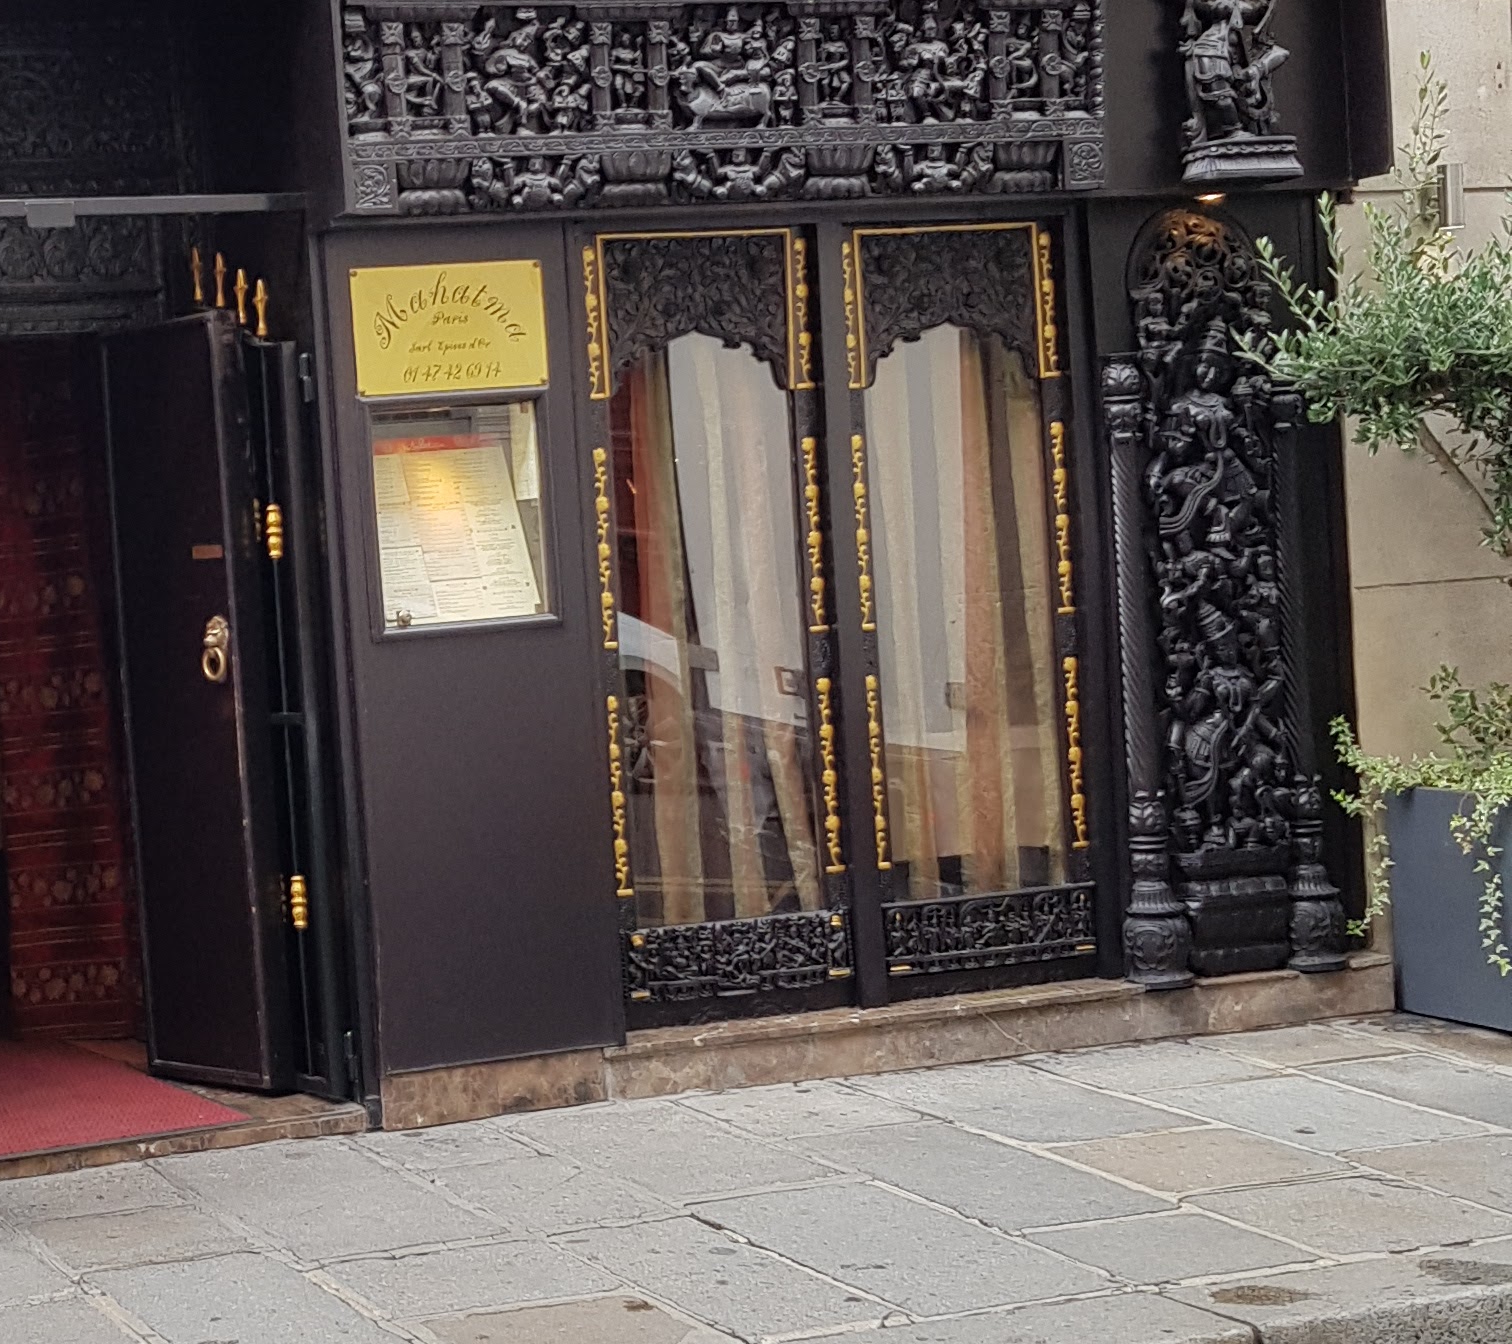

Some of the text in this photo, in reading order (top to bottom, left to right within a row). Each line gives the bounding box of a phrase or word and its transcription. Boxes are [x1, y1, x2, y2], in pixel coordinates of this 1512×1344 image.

[373, 270, 527, 350] Mahatma
[431, 311, 469, 326] Paris
[403, 361, 502, 383] 01 47 42 69 14
